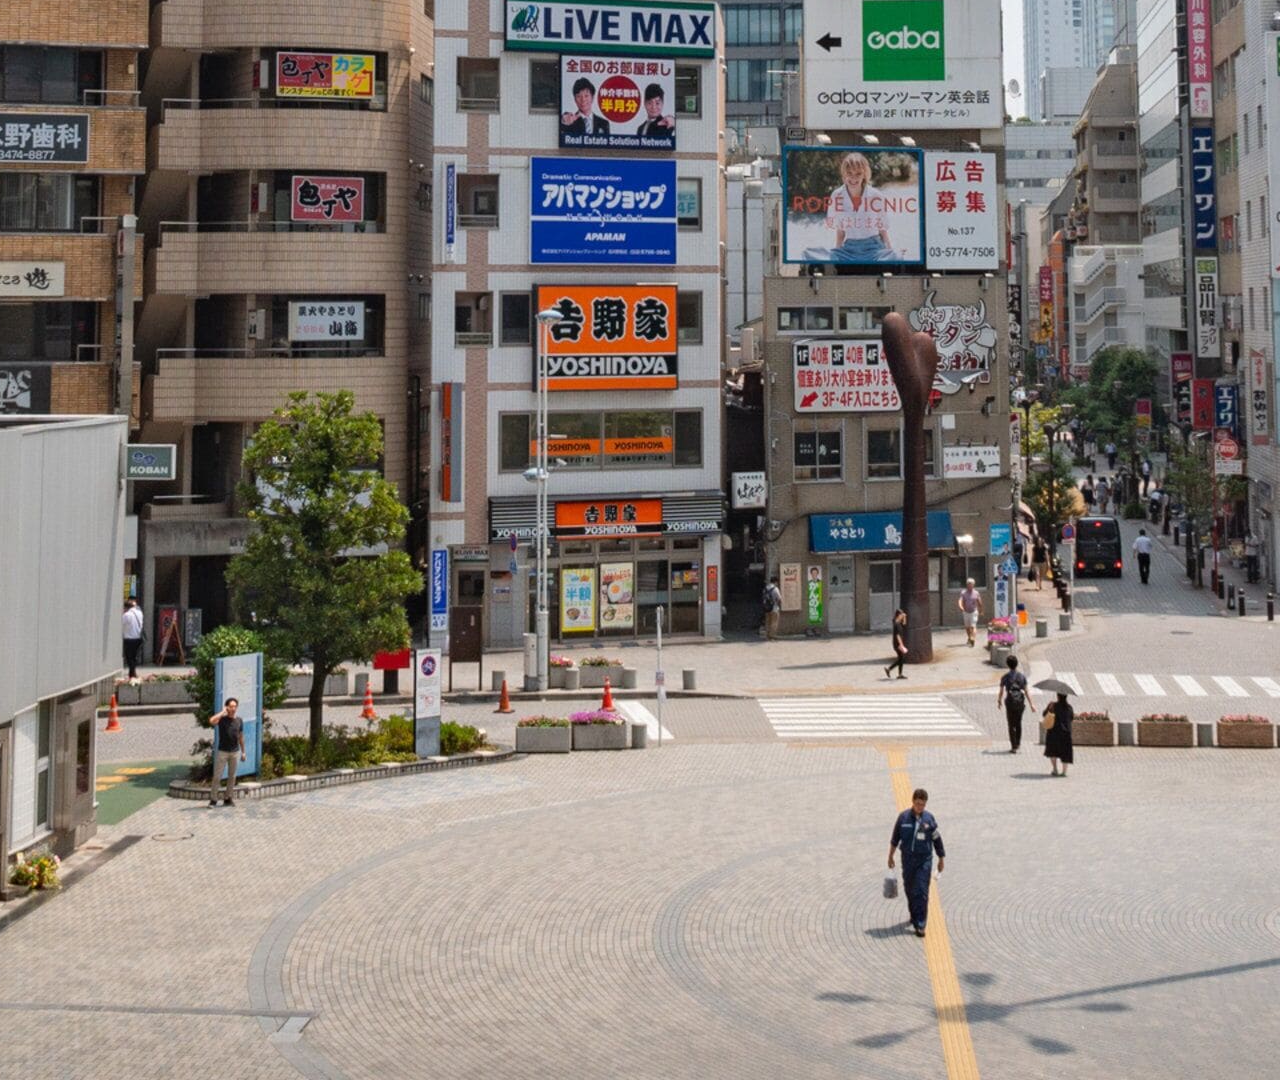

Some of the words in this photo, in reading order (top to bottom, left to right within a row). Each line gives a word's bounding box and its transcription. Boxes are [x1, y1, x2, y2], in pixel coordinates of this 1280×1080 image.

[542, 6, 621, 42] LiVE
[631, 10, 712, 46] MAX
[566, 58, 671, 77] 全国のお部屋探し
[601, 98, 638, 114] 半月分
[565, 134, 582, 146] Real
[582, 135, 608, 146] Estate
[608, 136, 641, 147] Solution
[641, 137, 672, 148] Network
[935, 159, 986, 184] 広告
[1191, 135, 1217, 240] エフワン
[296, 178, 359, 219] 包丁や
[541, 183, 667, 211] アパマンショップ
[935, 190, 987, 214] 募集
[584, 232, 626, 242] APAMAN
[947, 226, 976, 237] No.137
[928, 246, 996, 258] 03-5774-7506
[797, 345, 810, 365] 1F
[810, 345, 830, 366] 40席
[831, 345, 845, 365] 3F
[845, 345, 865, 366] 40席
[866, 345, 879, 365] 4F
[547, 354, 669, 377] YOSHINOYA
[1217, 386, 1234, 428] エフワ
[613, 440, 665, 453] YOSHINOYA
[130, 465, 169, 475] KOBAN
[583, 524, 639, 536] YOSHINOYA
[666, 520, 719, 533] YOSHINOYA
[829, 527, 865, 540] やきとり
[565, 586, 592, 602] 半額
